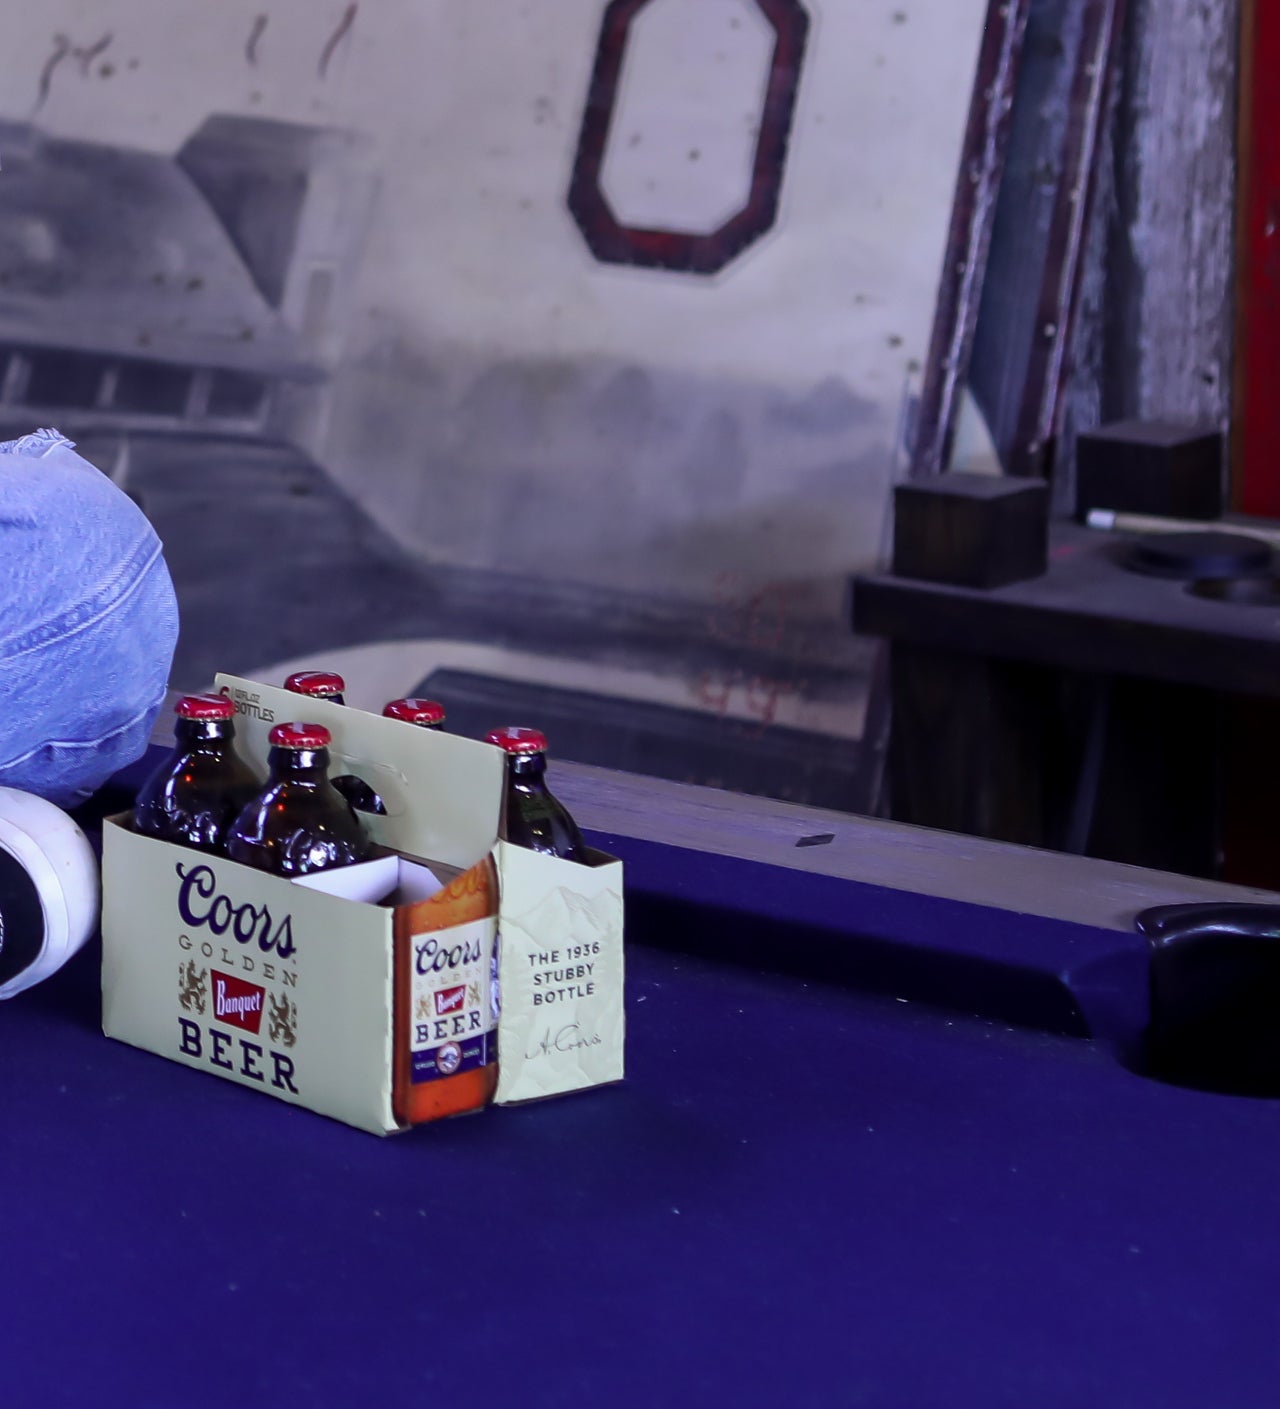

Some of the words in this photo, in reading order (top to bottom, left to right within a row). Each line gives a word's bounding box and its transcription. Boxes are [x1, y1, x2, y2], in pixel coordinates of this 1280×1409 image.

[234, 699, 275, 723] BOTTLES
[175, 861, 297, 960] Coors
[178, 934, 298, 988] GOLDEN
[415, 937, 482, 976] Coors
[528, 950, 561, 967] THE
[567, 941, 601, 960] 1936
[533, 963, 595, 986] STUBBY
[216, 979, 262, 1022] Banquet
[533, 982, 595, 1007] BOTTLE
[415, 1010, 482, 1044] BEER
[178, 1016, 300, 1095] BEER
